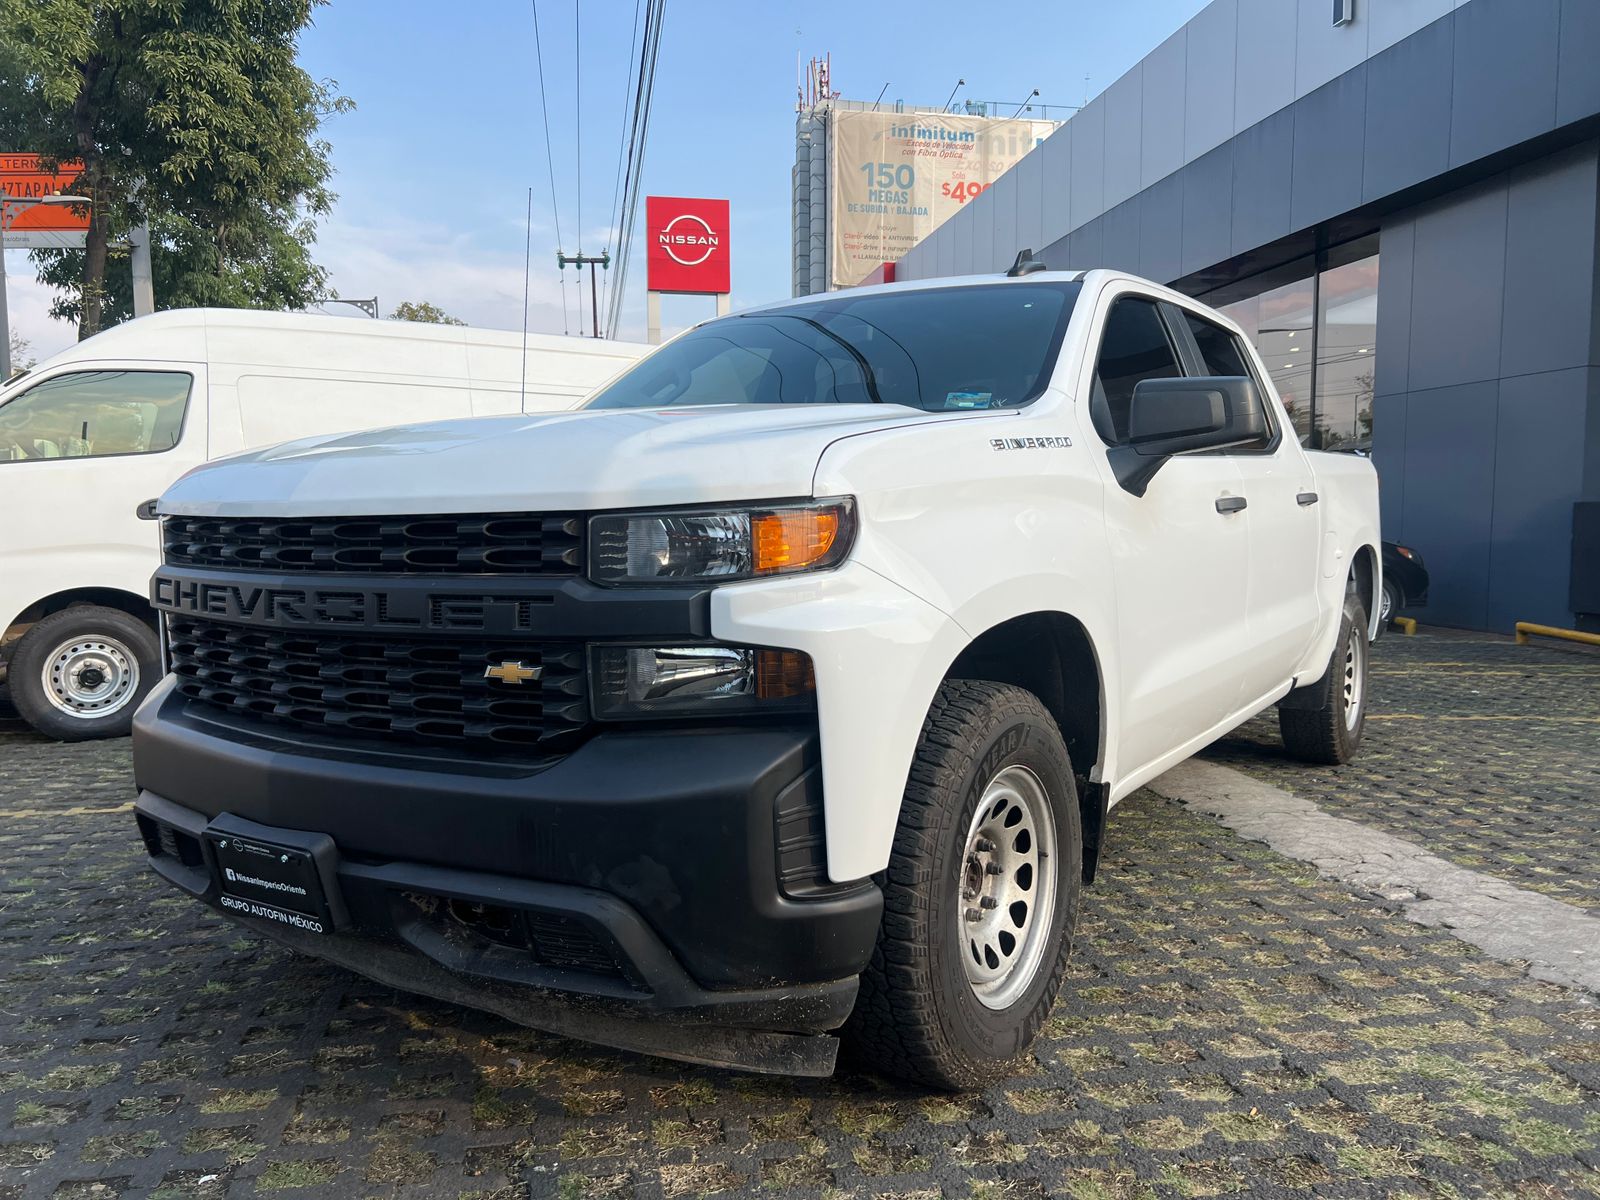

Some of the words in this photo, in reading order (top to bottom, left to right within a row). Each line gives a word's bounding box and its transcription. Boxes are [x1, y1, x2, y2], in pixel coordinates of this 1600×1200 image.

[891, 123, 975, 142] infinitum
[906, 139, 931, 148] Exceso
[931, 141, 941, 149] de
[942, 141, 975, 150] Velocidad
[917, 148, 938, 157] Fibra
[860, 161, 915, 190] 150
[868, 189, 909, 205] MEGAS
[847, 203, 860, 213] DE
[860, 203, 889, 214] SUBIDA
[896, 206, 929, 216] BAJADA
[659, 234, 719, 246] NISSAN
[990, 436, 1073, 451] SILVERADO
[153, 576, 556, 631] CHEVROLET
[236, 873, 307, 895] NissanImperioOriente
[220, 896, 250, 912] GRUPO
[251, 904, 288, 924] AUTOFIN
[289, 914, 324, 934] MÉXICO
